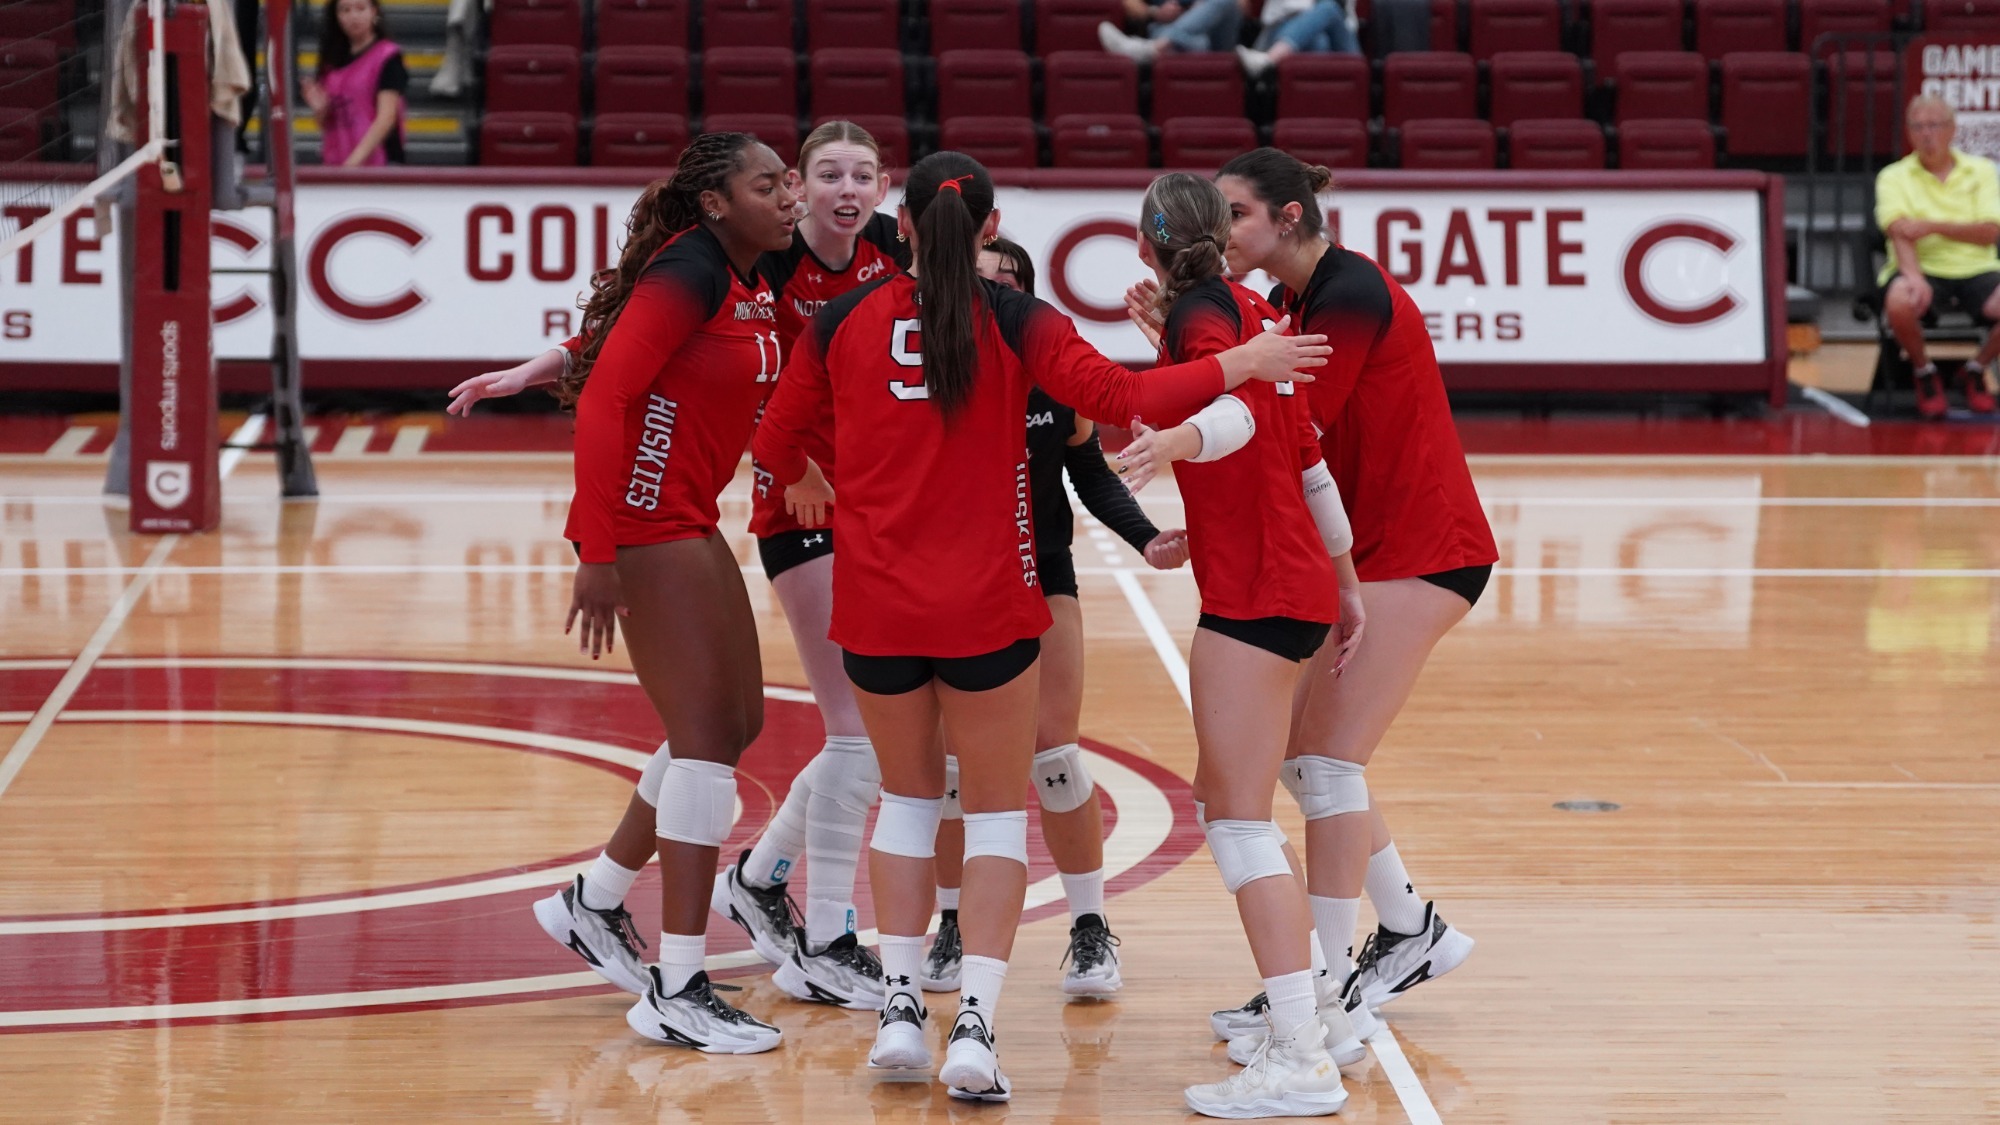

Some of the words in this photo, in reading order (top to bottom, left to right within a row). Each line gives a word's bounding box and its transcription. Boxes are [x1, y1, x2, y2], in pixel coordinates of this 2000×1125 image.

[160, 320, 179, 378] sports
[755, 330, 781, 383] 11
[159, 378, 178, 450] imports
[624, 393, 678, 511] HUSKIES
